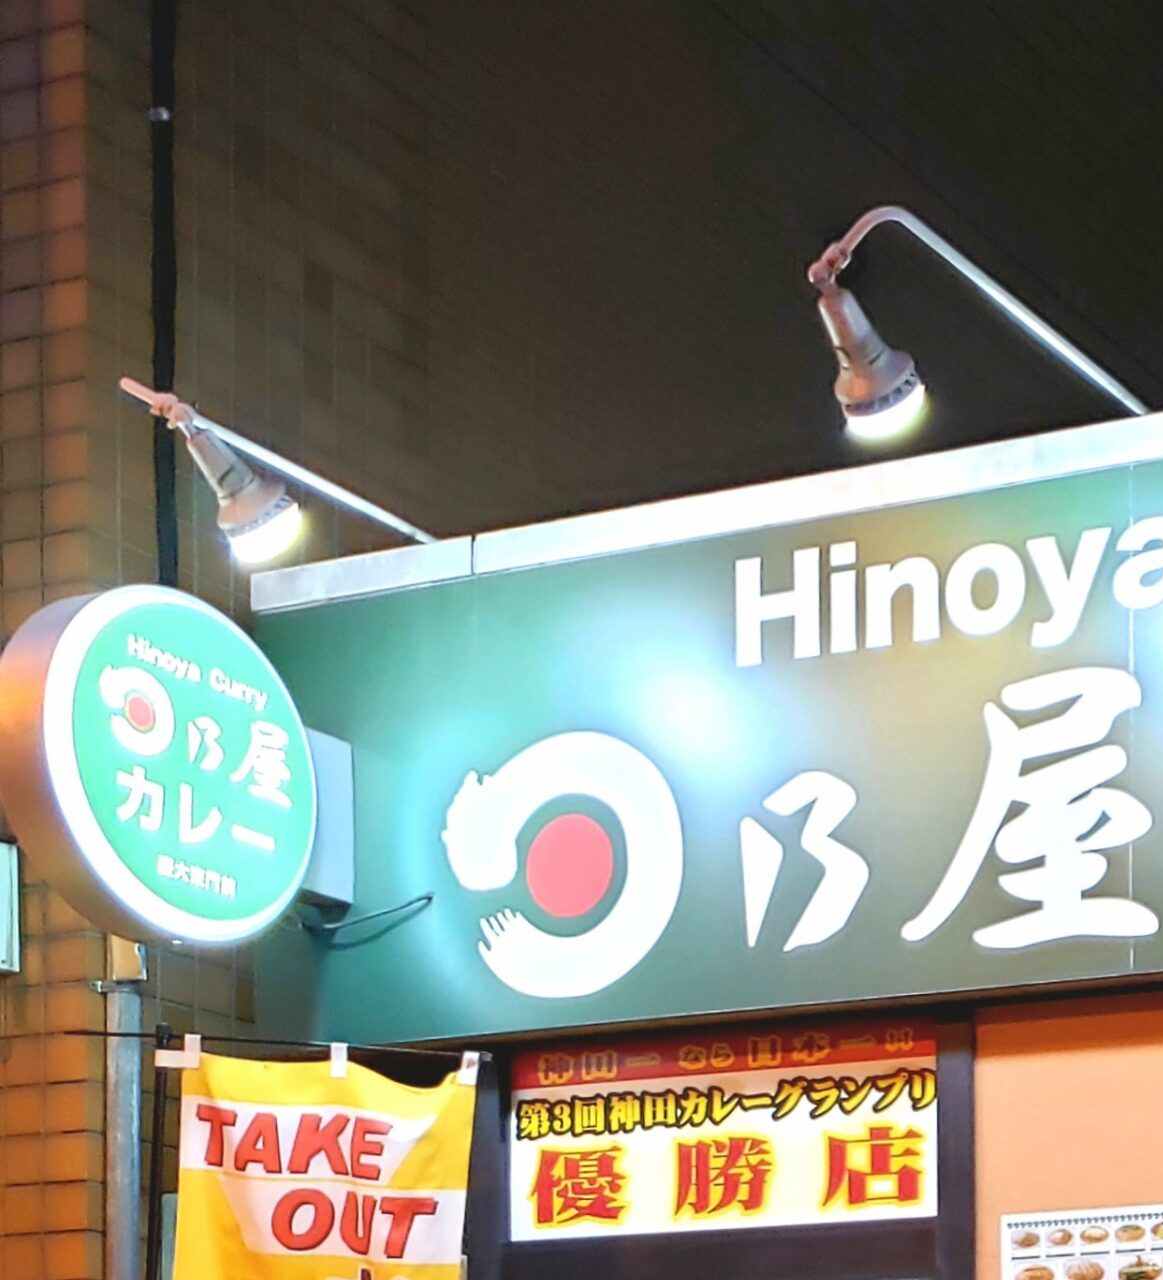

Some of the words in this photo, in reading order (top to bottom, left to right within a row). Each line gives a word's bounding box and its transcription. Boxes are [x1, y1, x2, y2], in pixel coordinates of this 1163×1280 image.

[127, 633, 202, 682] Hinoya
[209, 668, 268, 711] Curry
[115, 765, 276, 852] カレー
[197, 1104, 393, 1180] TAKE
[517, 1068, 936, 1139] 第3回神田カレーグランプリ
[529, 1126, 926, 1226] 優勝店
[271, 1188, 438, 1259] OUT
